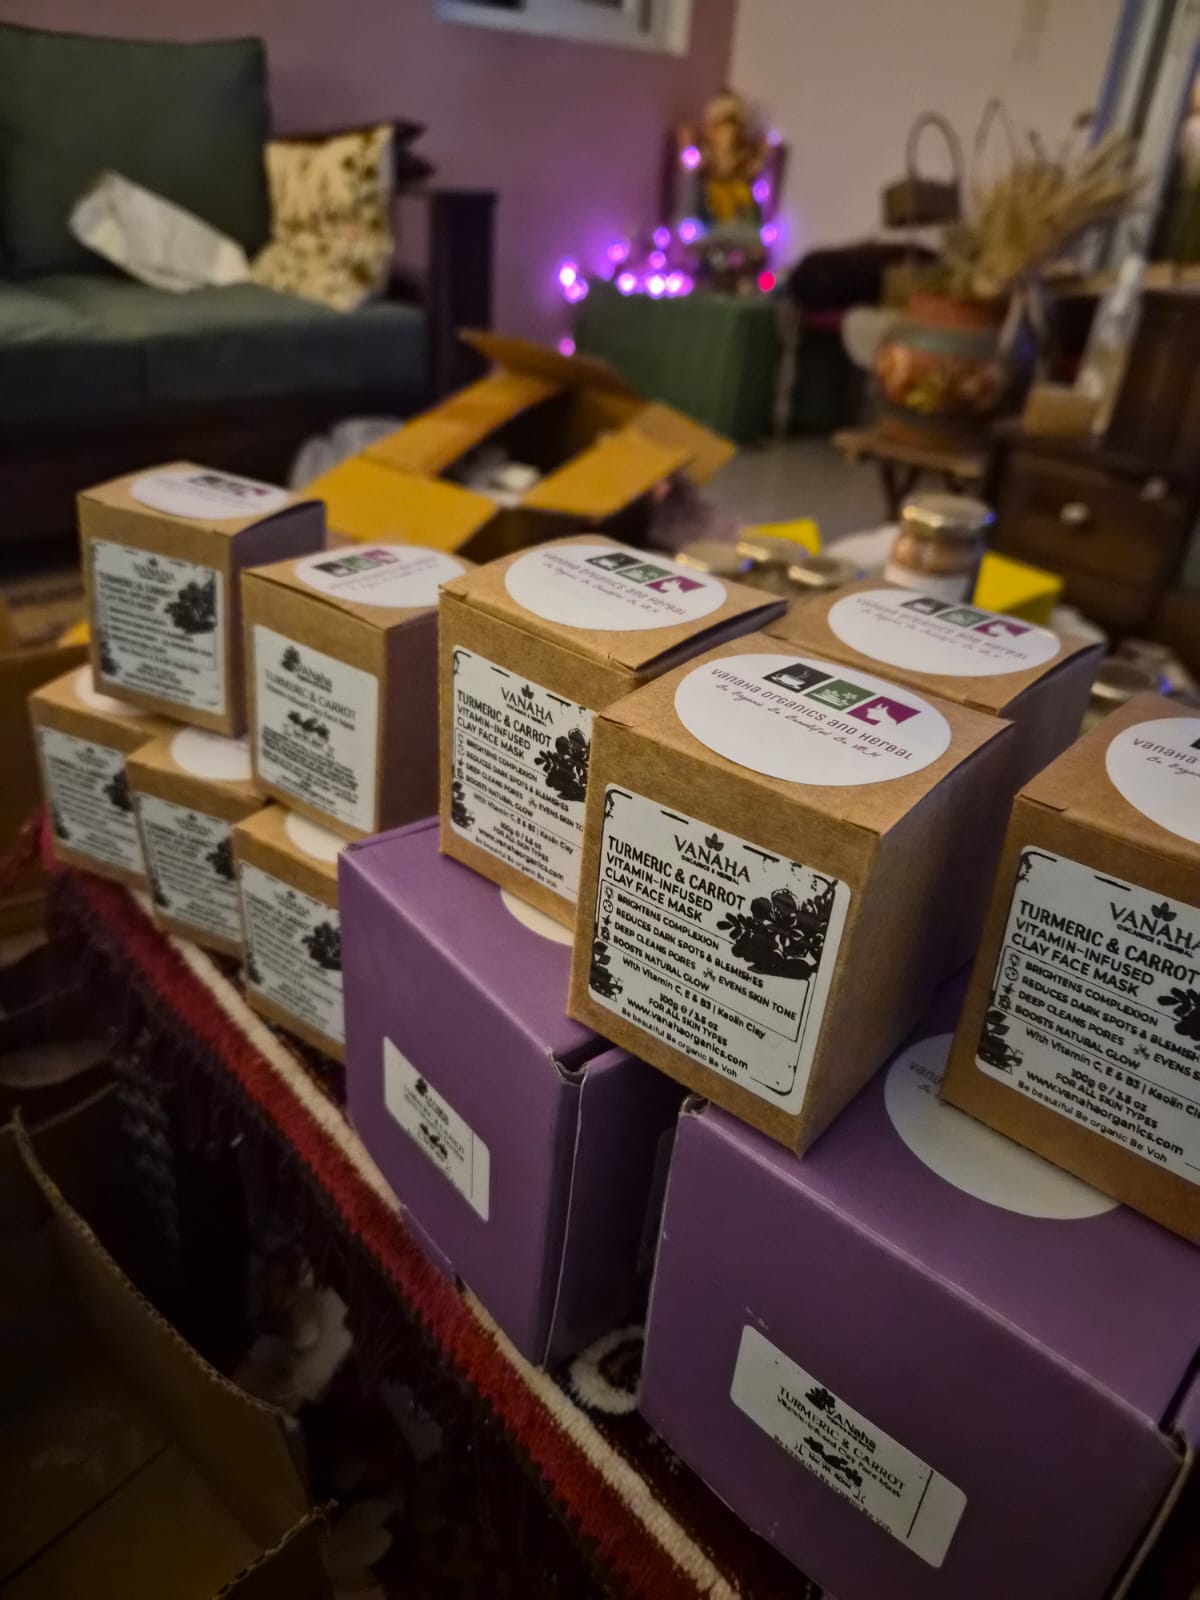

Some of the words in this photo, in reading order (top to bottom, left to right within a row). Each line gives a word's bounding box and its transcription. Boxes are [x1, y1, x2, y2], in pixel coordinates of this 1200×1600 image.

[457, 716, 477, 732] CLAY
[478, 727, 498, 746] FACE
[458, 690, 502, 723] TURMERIC
[513, 720, 552, 747] CARROT
[458, 706, 531, 750] VITAMIN-INFUSED
[501, 687, 554, 724] VANAHA
[607, 852, 713, 911] VITAMIN-INFUSED
[608, 835, 672, 877] TURMERIC
[689, 874, 746, 910] CARROT
[674, 835, 750, 882] VANAHA
[605, 867, 634, 888] CLAY
[635, 881, 665, 905] FACE
[667, 897, 702, 923] MASK
[617, 893, 661, 922] BRIGHTENS
[662, 917, 719, 950] COMPLEXION
[613, 935, 643, 957] BOOSTS
[644, 952, 682, 978] NATURAL
[683, 973, 710, 991] GLOW
[614, 921, 635, 937] DEEP
[636, 933, 667, 955] CLEANS
[668, 950, 696, 970] PORES
[616, 907, 651, 932] REDUCES
[653, 927, 676, 944] DARK
[677, 939, 705, 959] SPOTS
[714, 958, 763, 988] BLEMISHES
[1011, 932, 1050, 956] CLAY
[1051, 949, 1090, 976] FACE
[1093, 968, 1139, 997] MASK
[1016, 917, 1154, 985] VITAMIN-INFUSED
[1020, 900, 1103, 947] TURMERIC
[1125, 945, 1200, 985] CARROT
[622, 956, 641, 972] With
[642, 967, 673, 990] Vitamin
[700, 998, 711, 1010] B3
[717, 1007, 744, 1027] Kaolin
[746, 1022, 766, 1039] Clay
[648, 998, 665, 1012] FOR
[665, 1008, 681, 1022] ALL
[682, 1016, 701, 1032] SKIN
[702, 1026, 727, 1046] TYPES
[718, 975, 747, 996] EVENS
[748, 990, 770, 1007] SKIN
[772, 1002, 796, 1021] TONE
[1018, 990, 1045, 1007] DEEP
[1046, 1004, 1086, 1028] CLEANS
[1088, 1023, 1124, 1046] PORES
[1022, 976, 1068, 1003] REDUCES
[1070, 998, 1100, 1018] DARK
[1102, 1013, 1138, 1035] SPOTS
[1150, 1034, 1200, 1066] BLEMISH
[1025, 961, 1082, 993] BRIGHTENS
[1085, 988, 1158, 1026] COMPLEXION
[621, 1007, 631, 1018] Be
[666, 1033, 676, 1043] Be
[678, 1041, 706, 1061] organic
[708, 1057, 719, 1067] Be
[627, 998, 748, 1069] www.vanahaorganics.com
[707, 1021, 718, 1031] oz
[1015, 1005, 1054, 1029] BOOSTS
[1055, 1024, 1103, 1054] NATURAL
[1105, 1048, 1140, 1069] GLOW
[1026, 1027, 1049, 1045] With
[1051, 1039, 1090, 1066] Vitamin
[1125, 1076, 1140, 1089] B3
[1148, 1087, 1183, 1110] Kaolin
[1153, 1053, 1191, 1076] EVENS
[1018, 1080, 1030, 1092] Be
[1075, 1110, 1088, 1122] Be
[1090, 1119, 1127, 1142] organic
[1129, 1138, 1144, 1151] Be
[1027, 1071, 1183, 1155] www.vanahaorganics.com
[1055, 1072, 1076, 1088] FOR
[1077, 1084, 1096, 1099] ALL
[1098, 1094, 1123, 1112] SKIN
[1126, 1106, 1158, 1129] TYPES
[1133, 1101, 1147, 1112] oz
[779, 1385, 840, 1441] TURMERIC
[853, 1447, 904, 1490] CARROT
